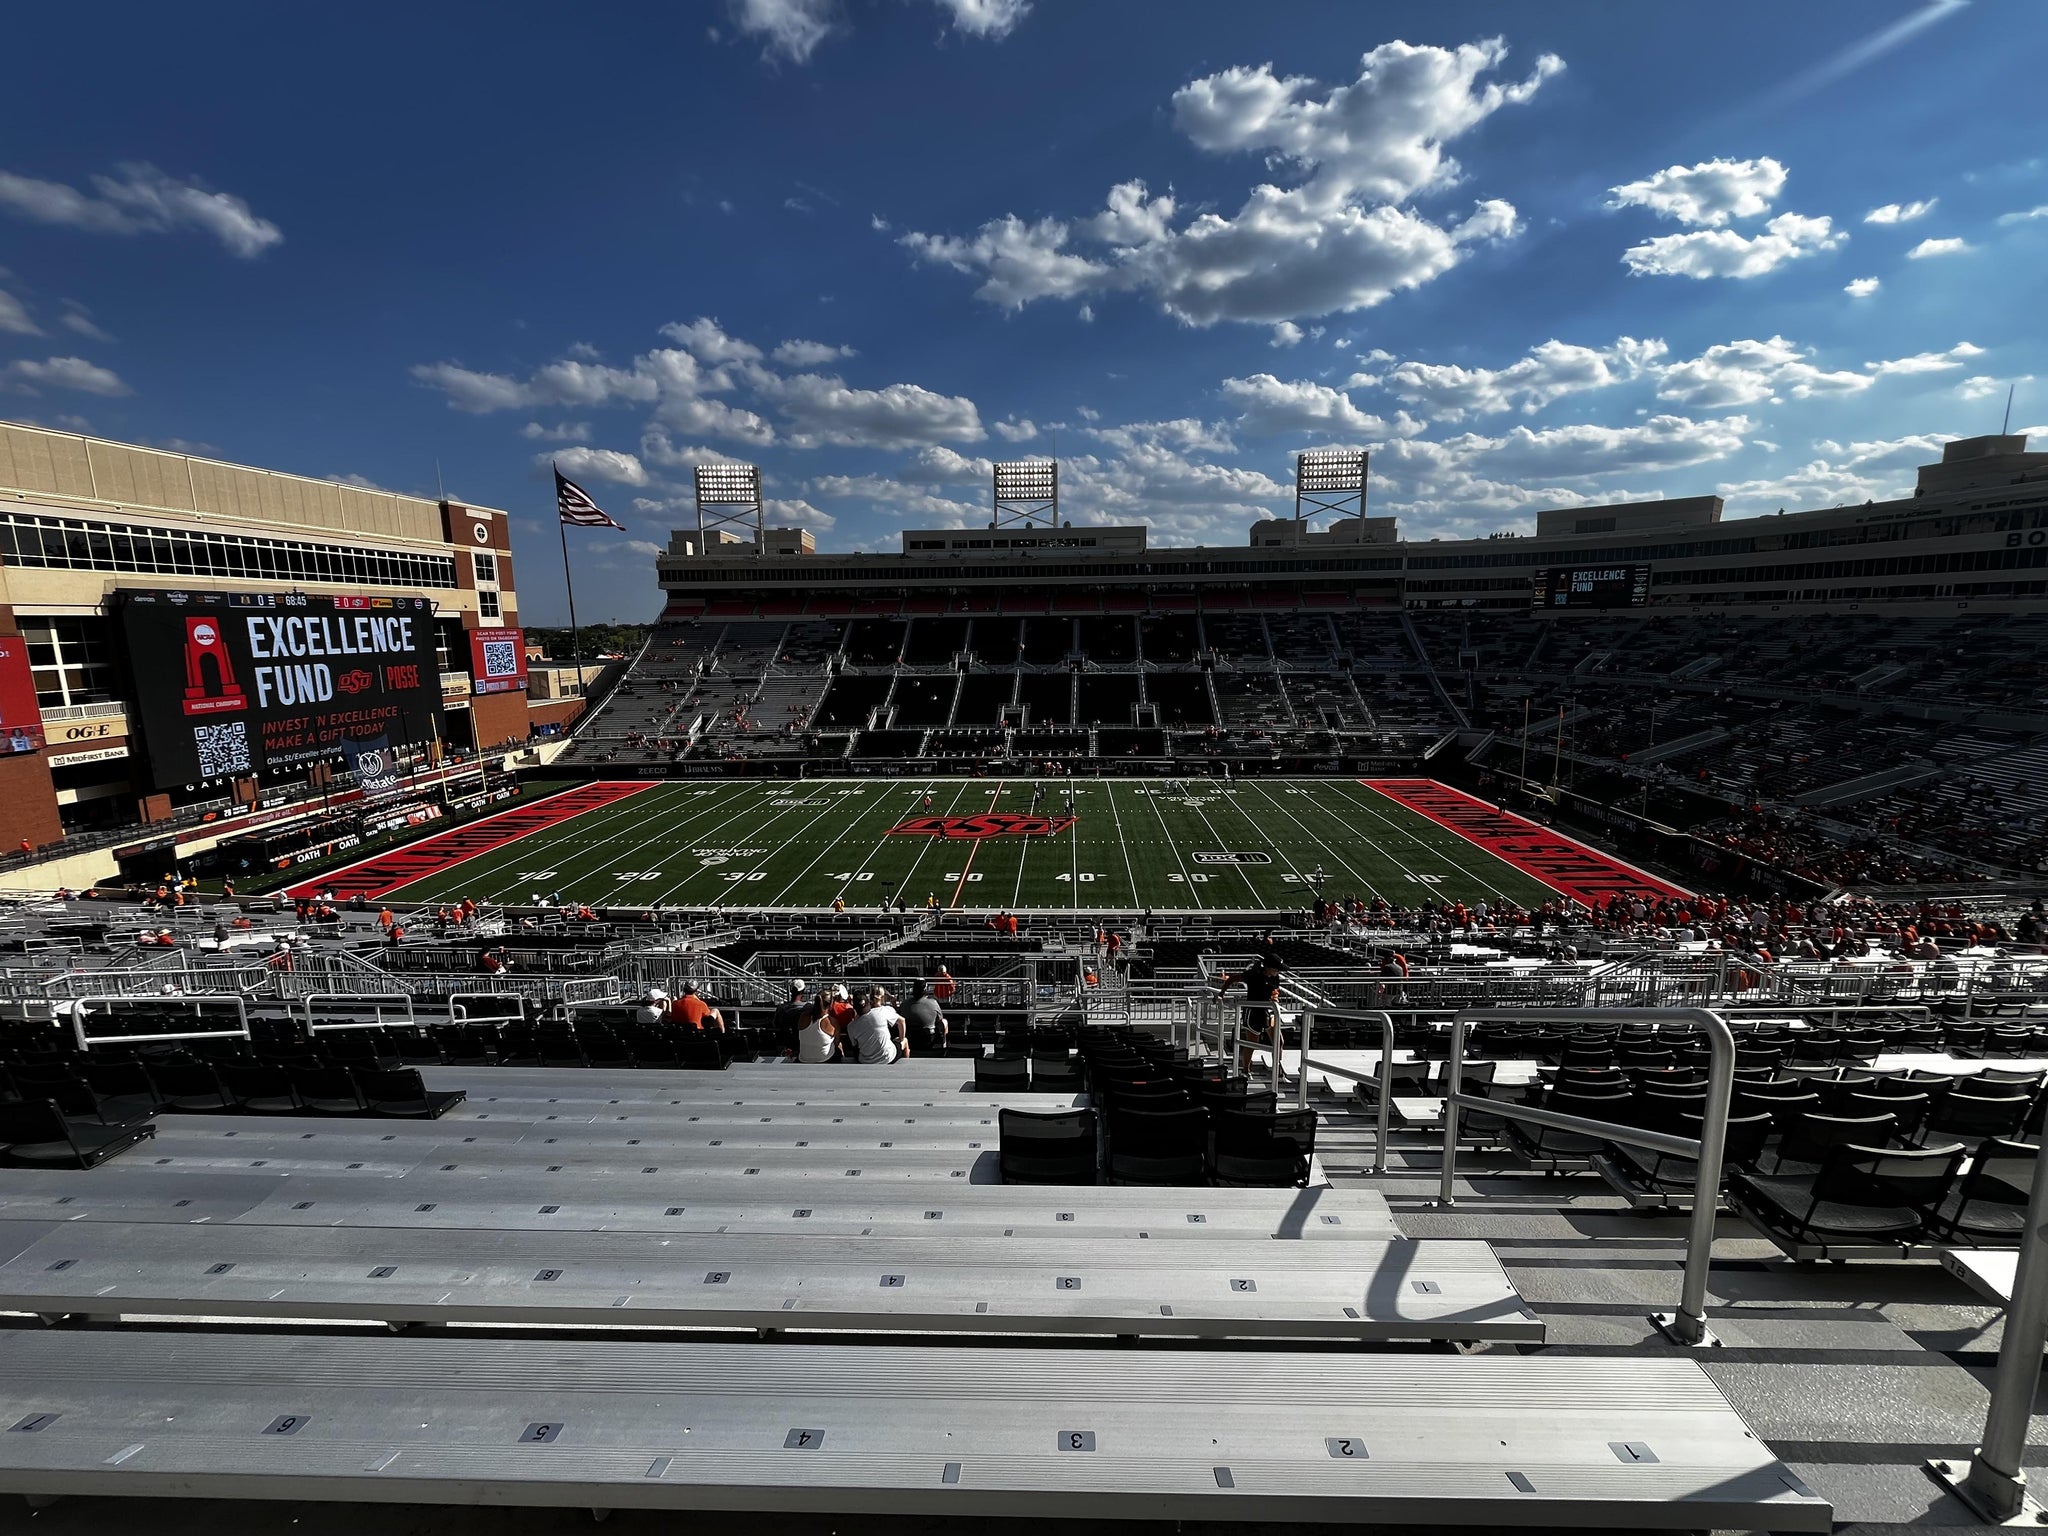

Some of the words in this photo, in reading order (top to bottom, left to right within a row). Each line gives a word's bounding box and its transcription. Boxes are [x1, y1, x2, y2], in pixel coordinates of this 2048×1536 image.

[1572, 569, 1626, 581] EXCELLENCE
[1571, 582, 1593, 592] FUND
[257, 595, 264, 606] 0
[285, 595, 307, 606] 68:45
[343, 597, 350, 607] 0
[246, 616, 415, 658] EXCELLENCE
[254, 663, 333, 708] FUND
[337, 669, 373, 694] OSU
[386, 665, 420, 690] POSSE
[262, 717, 310, 735] INVEST
[330, 706, 398, 723] EXCELLENCE
[265, 734, 302, 751] MAKE
[306, 734, 316, 745] A
[319, 728, 346, 743] GIFT
[349, 722, 385, 737] TODAY
[104, 750, 125, 758] BANK
[186, 777, 236, 791] GARY
[496, 791, 510, 800] OATH
[471, 799, 487, 808] OATH
[1383, 785, 1540, 838] OKLAHOMA
[248, 812, 275, 825] Through
[339, 837, 360, 850] OATH
[312, 811, 566, 891] OKLAHOMA
[297, 850, 321, 863] OATH
[526, 871, 559, 880] 10
[1499, 845, 1670, 897] STATE
[1751, 867, 1761, 883] 34
[616, 872, 662, 881] 20
[723, 872, 768, 881] 30
[834, 872, 875, 882] 40
[943, 872, 985, 882] 50
[1055, 873, 1096, 882] 40
[1167, 873, 1211, 883] 30
[1280, 873, 1325, 883] 20
[1403, 874, 1443, 883] 10
[1062, 1213, 1068, 1221] 3
[56, 1260, 70, 1269] 9
[214, 1264, 227, 1273] 8
[1948, 1259, 1967, 1279] 18
[376, 1267, 389, 1277] 7
[543, 1270, 554, 1280] 6
[713, 1273, 723, 1283] 5
[889, 1276, 897, 1285] 4
[1064, 1278, 1073, 1288] 3
[1239, 1280, 1248, 1290] 2
[1422, 1282, 1430, 1292] 1
[22, 1415, 47, 1430] 7
[276, 1417, 297, 1432] 6
[532, 1425, 550, 1440] 5
[798, 1431, 811, 1446] 4
[1070, 1433, 1083, 1449] 3
[1338, 1440, 1353, 1456] 2
[1625, 1444, 1640, 1460] 1
